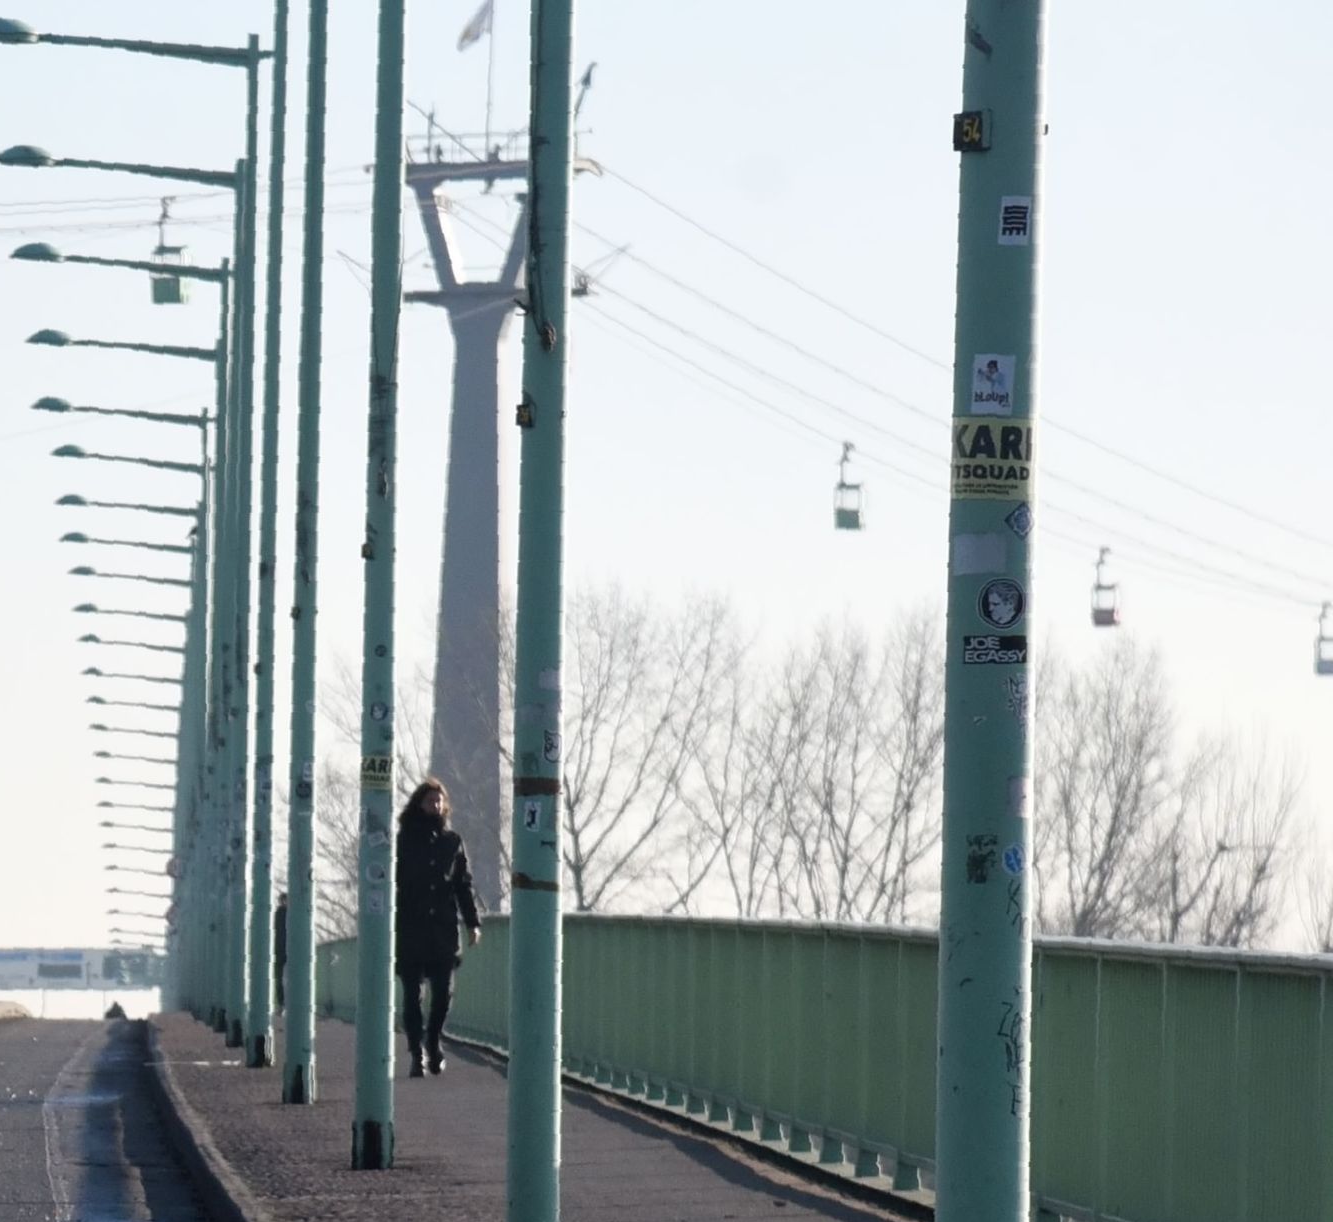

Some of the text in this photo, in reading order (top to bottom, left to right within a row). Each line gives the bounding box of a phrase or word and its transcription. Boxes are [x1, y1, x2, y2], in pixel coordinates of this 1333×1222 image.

[963, 117, 981, 142] 54
[966, 637, 1000, 649] JOE
[965, 650, 1026, 662] EGASSY
